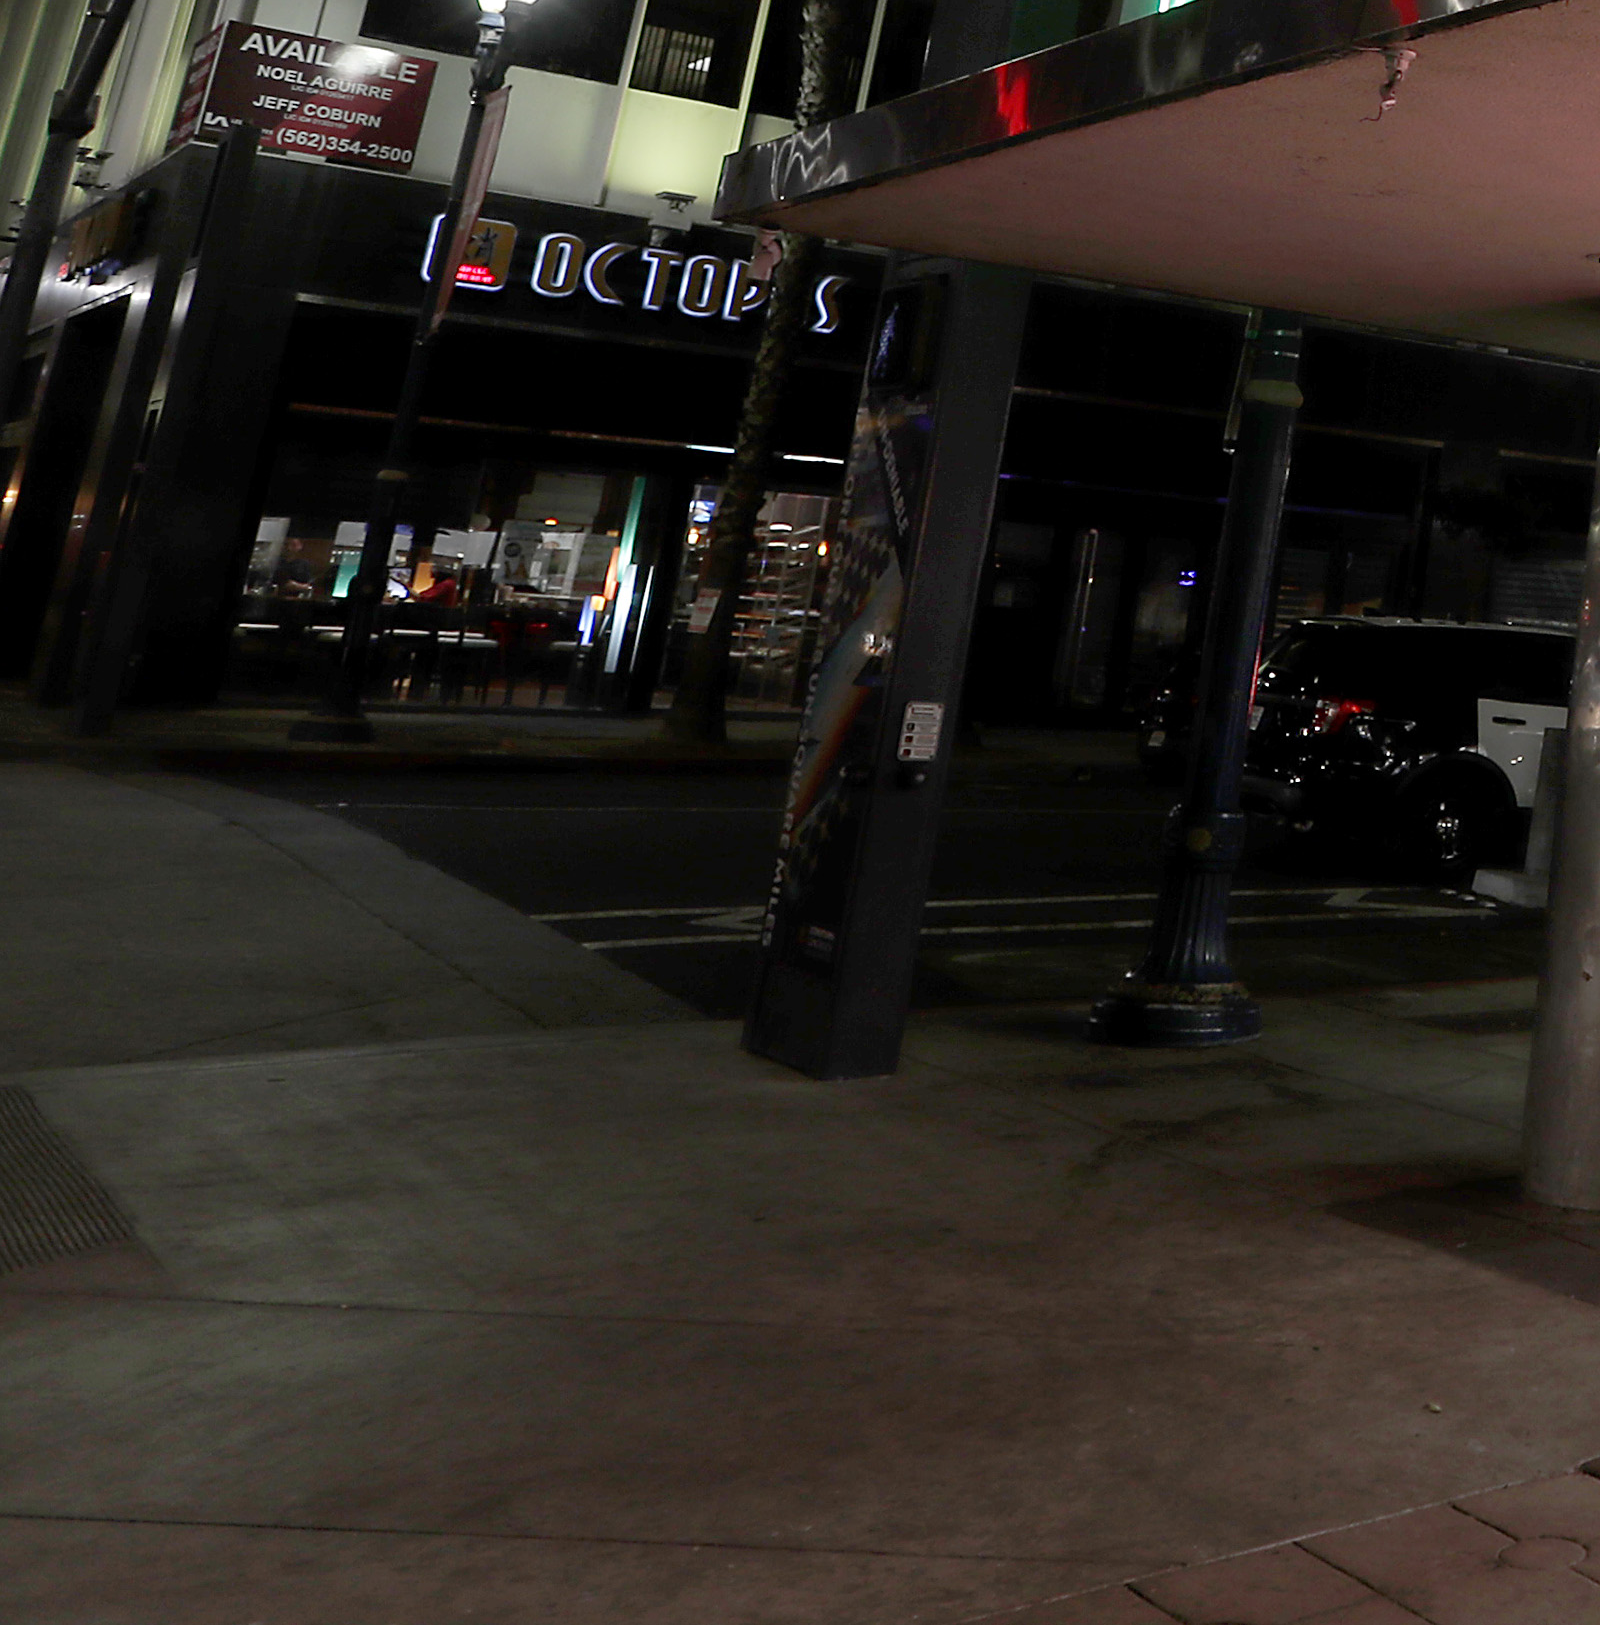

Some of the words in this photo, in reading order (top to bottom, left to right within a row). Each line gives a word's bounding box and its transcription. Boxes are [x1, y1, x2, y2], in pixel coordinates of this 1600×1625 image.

[240, 31, 420, 84] AVAILLE
[256, 63, 307, 86] NOEL
[310, 74, 393, 101] AGUIRRE
[252, 94, 300, 113] JEFF
[303, 102, 382, 128] COBURN
[275, 126, 414, 165] (562)354-2500
[530, 231, 853, 335] OCTOPS
[761, 857, 788, 948] MILES
